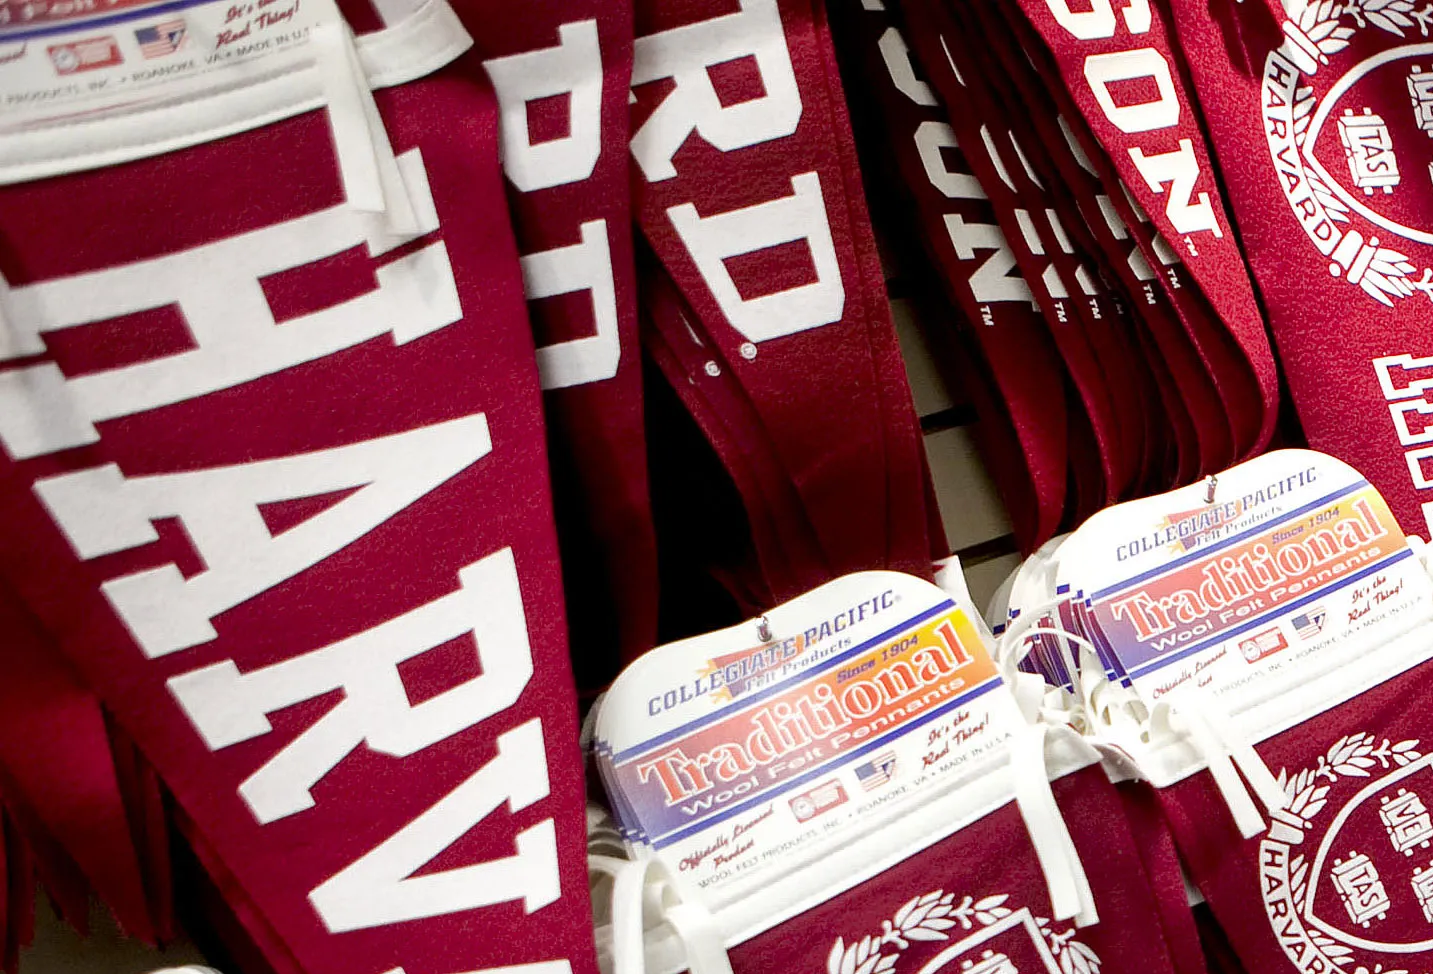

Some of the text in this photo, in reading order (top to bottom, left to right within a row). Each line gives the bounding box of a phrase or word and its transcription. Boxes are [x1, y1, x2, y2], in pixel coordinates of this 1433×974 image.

[1266, 59, 1333, 243] HARVARD
[1116, 466, 1317, 563] COLLEGIATE PACIFIC
[1272, 505, 1340, 545] Since 1904
[1111, 496, 1388, 645] Traditional
[1151, 545, 1382, 651] Wool Felt Pennants
[648, 635, 798, 717] COLLEGIATE
[837, 635, 919, 683] Since 1904
[639, 618, 975, 807] Traditional
[682, 677, 966, 817] Wool Felt Pennants
